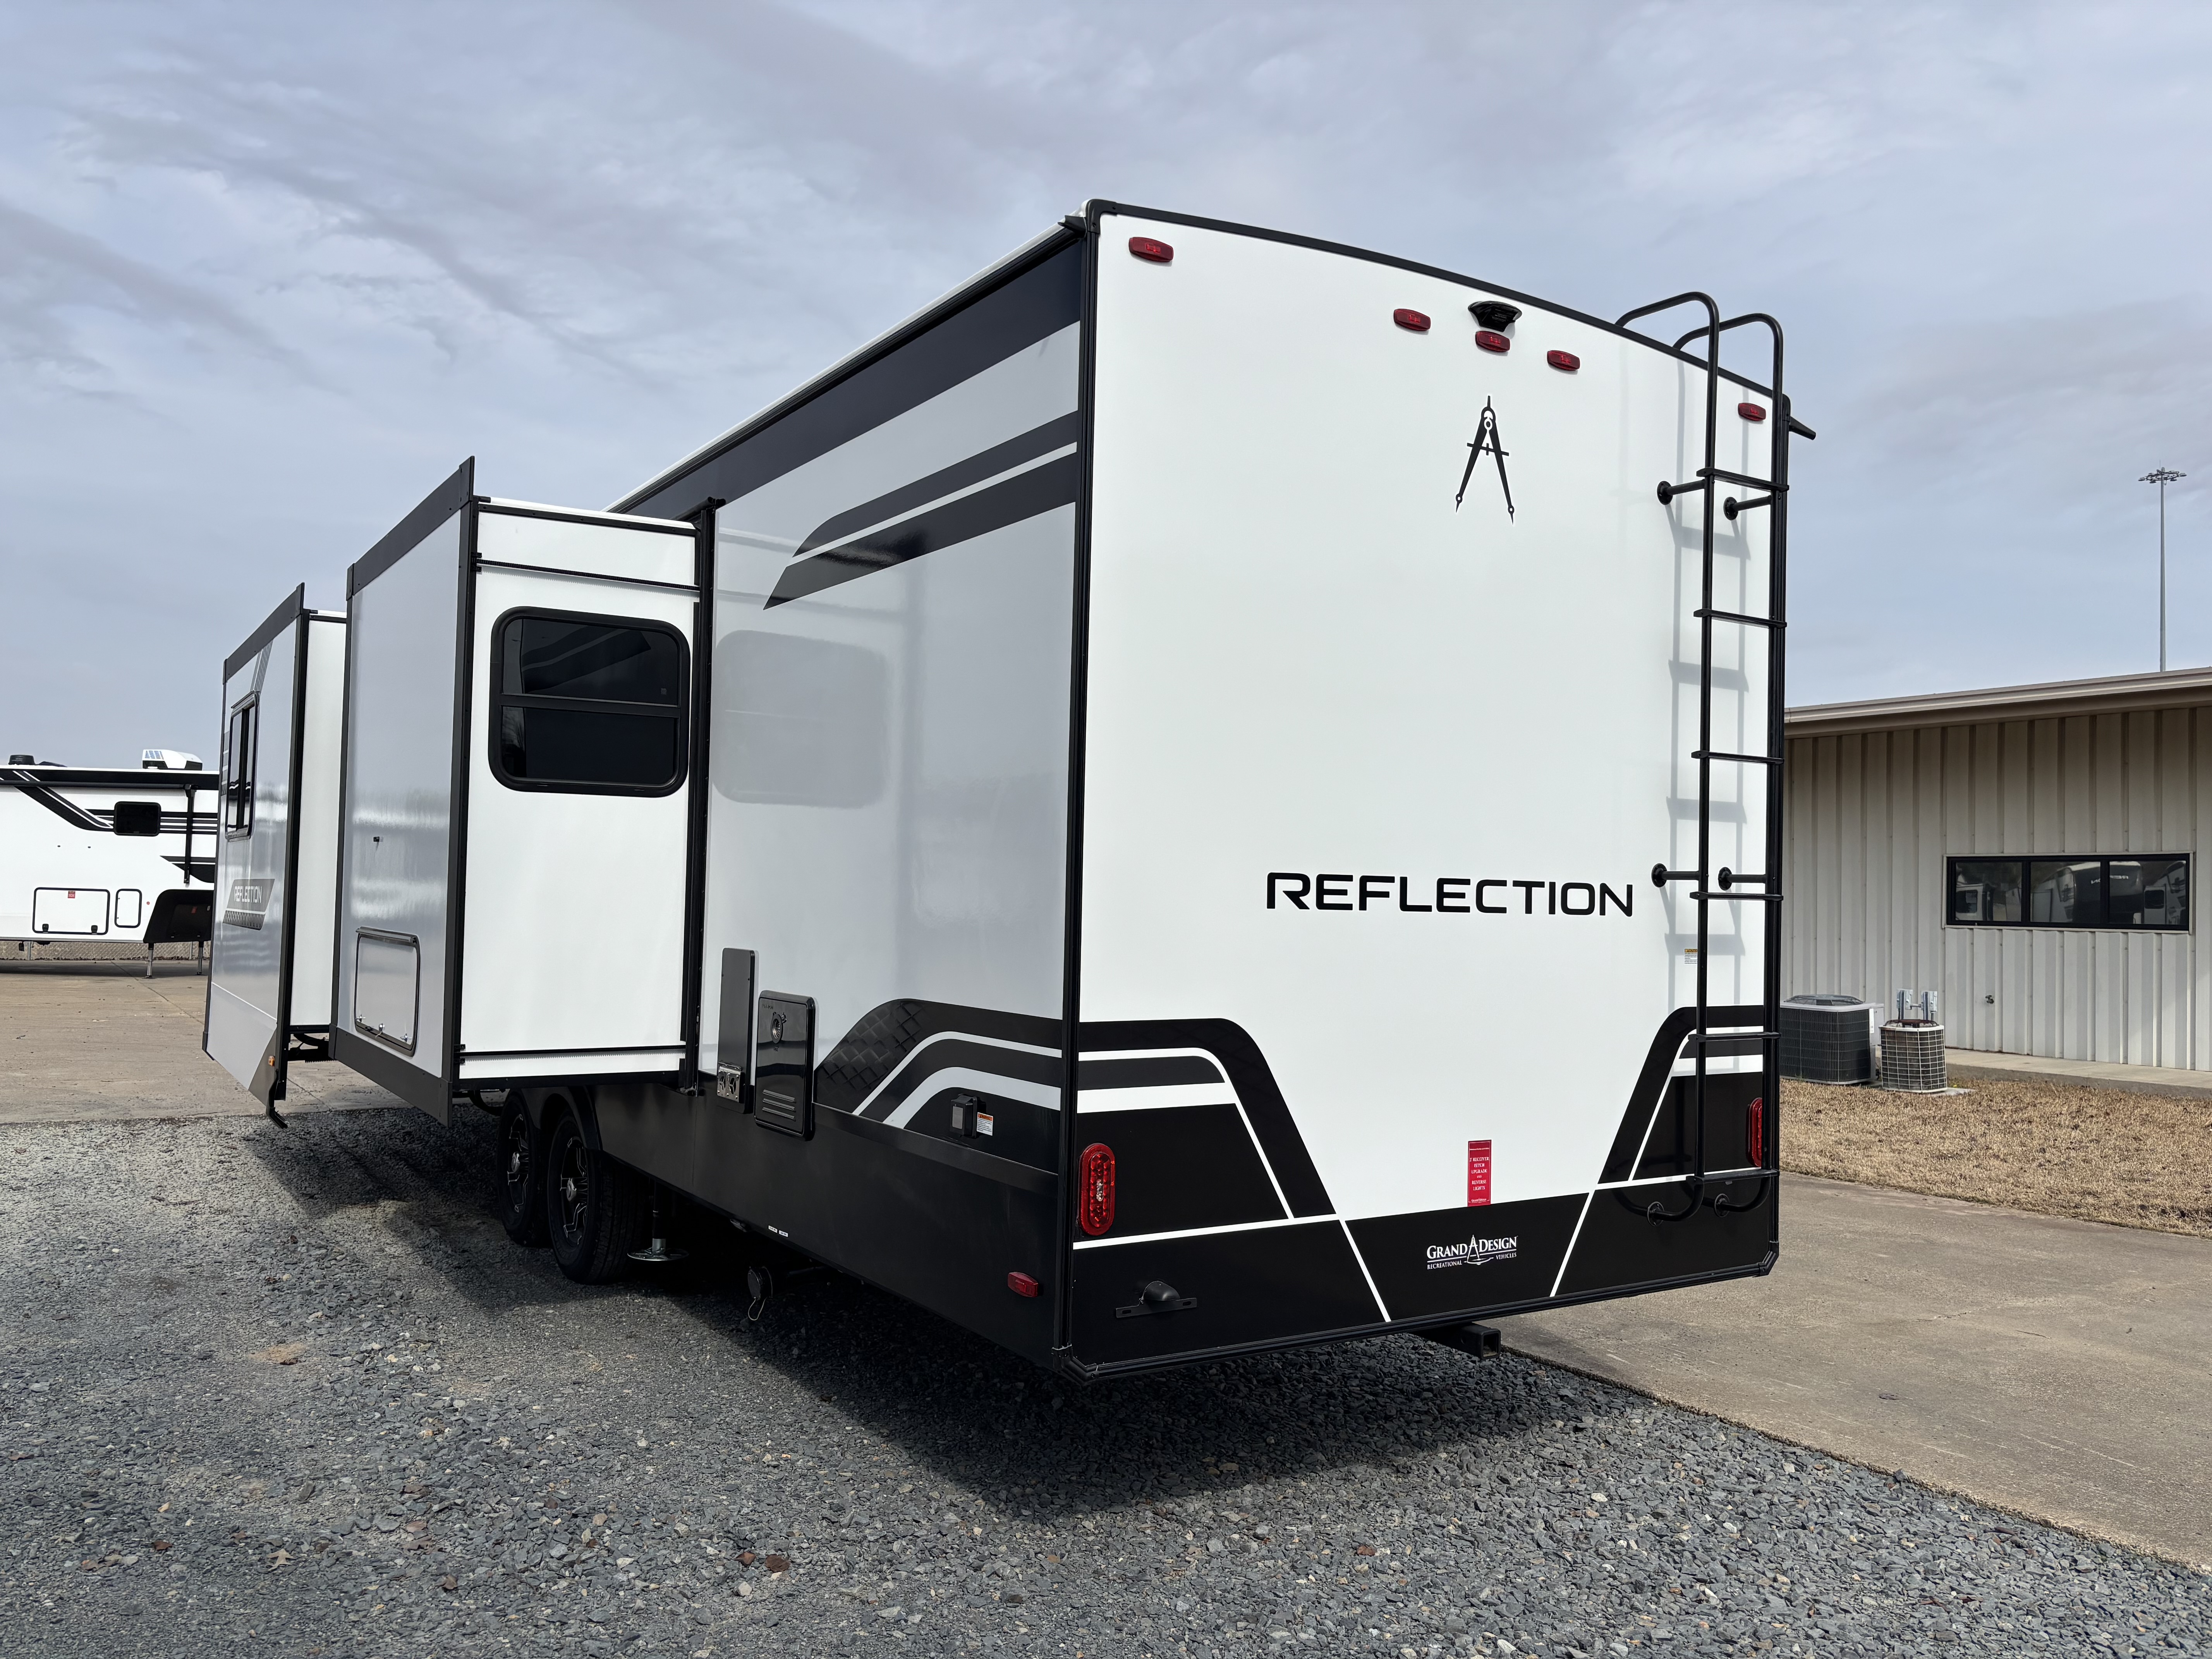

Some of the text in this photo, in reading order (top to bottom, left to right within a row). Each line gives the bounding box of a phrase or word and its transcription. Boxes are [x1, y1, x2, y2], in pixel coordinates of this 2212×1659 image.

[234, 886, 262, 903] REFLECTION
[1267, 872, 1632, 917] REFLECTION
[1427, 1237, 1517, 1259] GRAND DESIGN
[1427, 1260, 1462, 1270] RECREATIONAL
